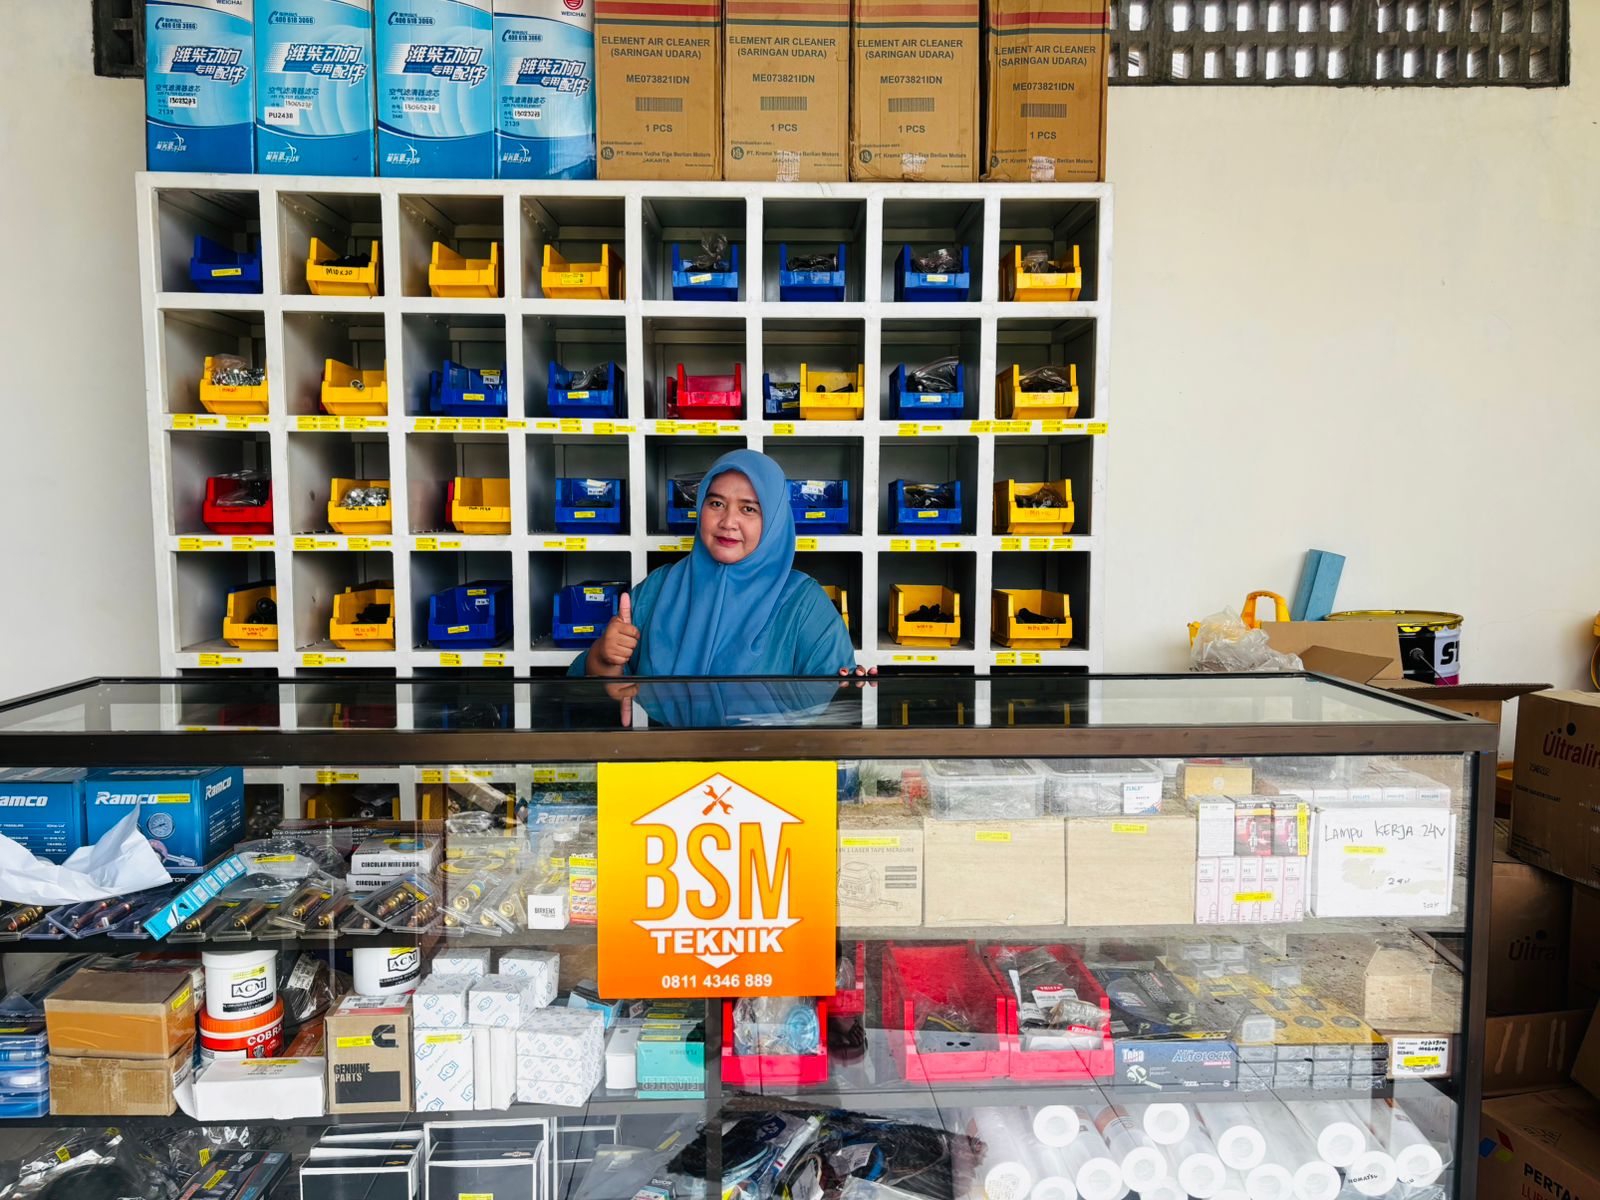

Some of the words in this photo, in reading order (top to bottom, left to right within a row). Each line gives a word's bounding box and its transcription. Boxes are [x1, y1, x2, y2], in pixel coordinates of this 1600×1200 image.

[602, 36, 646, 45] ELEMENT
[648, 37, 663, 46] AIR
[666, 38, 710, 47] CLEANER
[729, 36, 772, 45] ELEMENT
[774, 37, 790, 45] AIR
[792, 38, 836, 46] CLEANER
[857, 39, 900, 48] ELEMENT
[902, 39, 917, 48] AIR
[920, 39, 963, 48] CLEANER
[173, 46, 241, 63] 潍柴动力
[287, 44, 361, 63] 潍柴动力
[406, 46, 481, 63] 潍柴动力
[611, 49, 663, 58] (SARINGAN
[665, 50, 702, 60] UDARA)
[737, 48, 789, 57] (SARINGAN
[791, 49, 827, 58] UDARA)
[865, 50, 917, 59] (SARINGAN
[919, 50, 954, 59] UDARA)
[1035, 46, 1050, 54] AIR
[1053, 46, 1096, 54] CLEANER
[520, 59, 585, 76] 潍柴动力
[998, 58, 1050, 67] (SARINGAN
[1052, 57, 1087, 66] UDARA)
[195, 65, 248, 84] 专用配件
[311, 64, 367, 84] 专用配件
[432, 65, 488, 84] 专用配件
[626, 74, 690, 84] ME073821IDN
[752, 74, 815, 83] ME073821IDN
[880, 76, 942, 84] ME073821IDN
[541, 77, 589, 96] 专用配件
[1013, 83, 1074, 91] ME073821IDN
[646, 124, 650, 132] 1
[653, 124, 673, 133] PCS
[778, 124, 798, 132] PCS
[906, 125, 926, 133] PCS
[1030, 132, 1034, 140] 1
[1037, 132, 1056, 140] PCS
[205, 776, 232, 800] Ramco
[96, 792, 158, 805] Ramco
[1325, 825, 1363, 843] LAMPU
[1375, 820, 1414, 840] KERJA
[1422, 824, 1446, 840] 24V
[639, 822, 791, 920] BSM
[650, 929, 783, 954] TEKNIK
[392, 954, 416, 968] ACM
[662, 975, 697, 988] 0811
[704, 975, 740, 988] 4346
[745, 974, 772, 987] 889
[236, 981, 264, 994] ACM
[334, 1063, 370, 1074] GENUINE
[335, 1073, 362, 1082] PARTS
